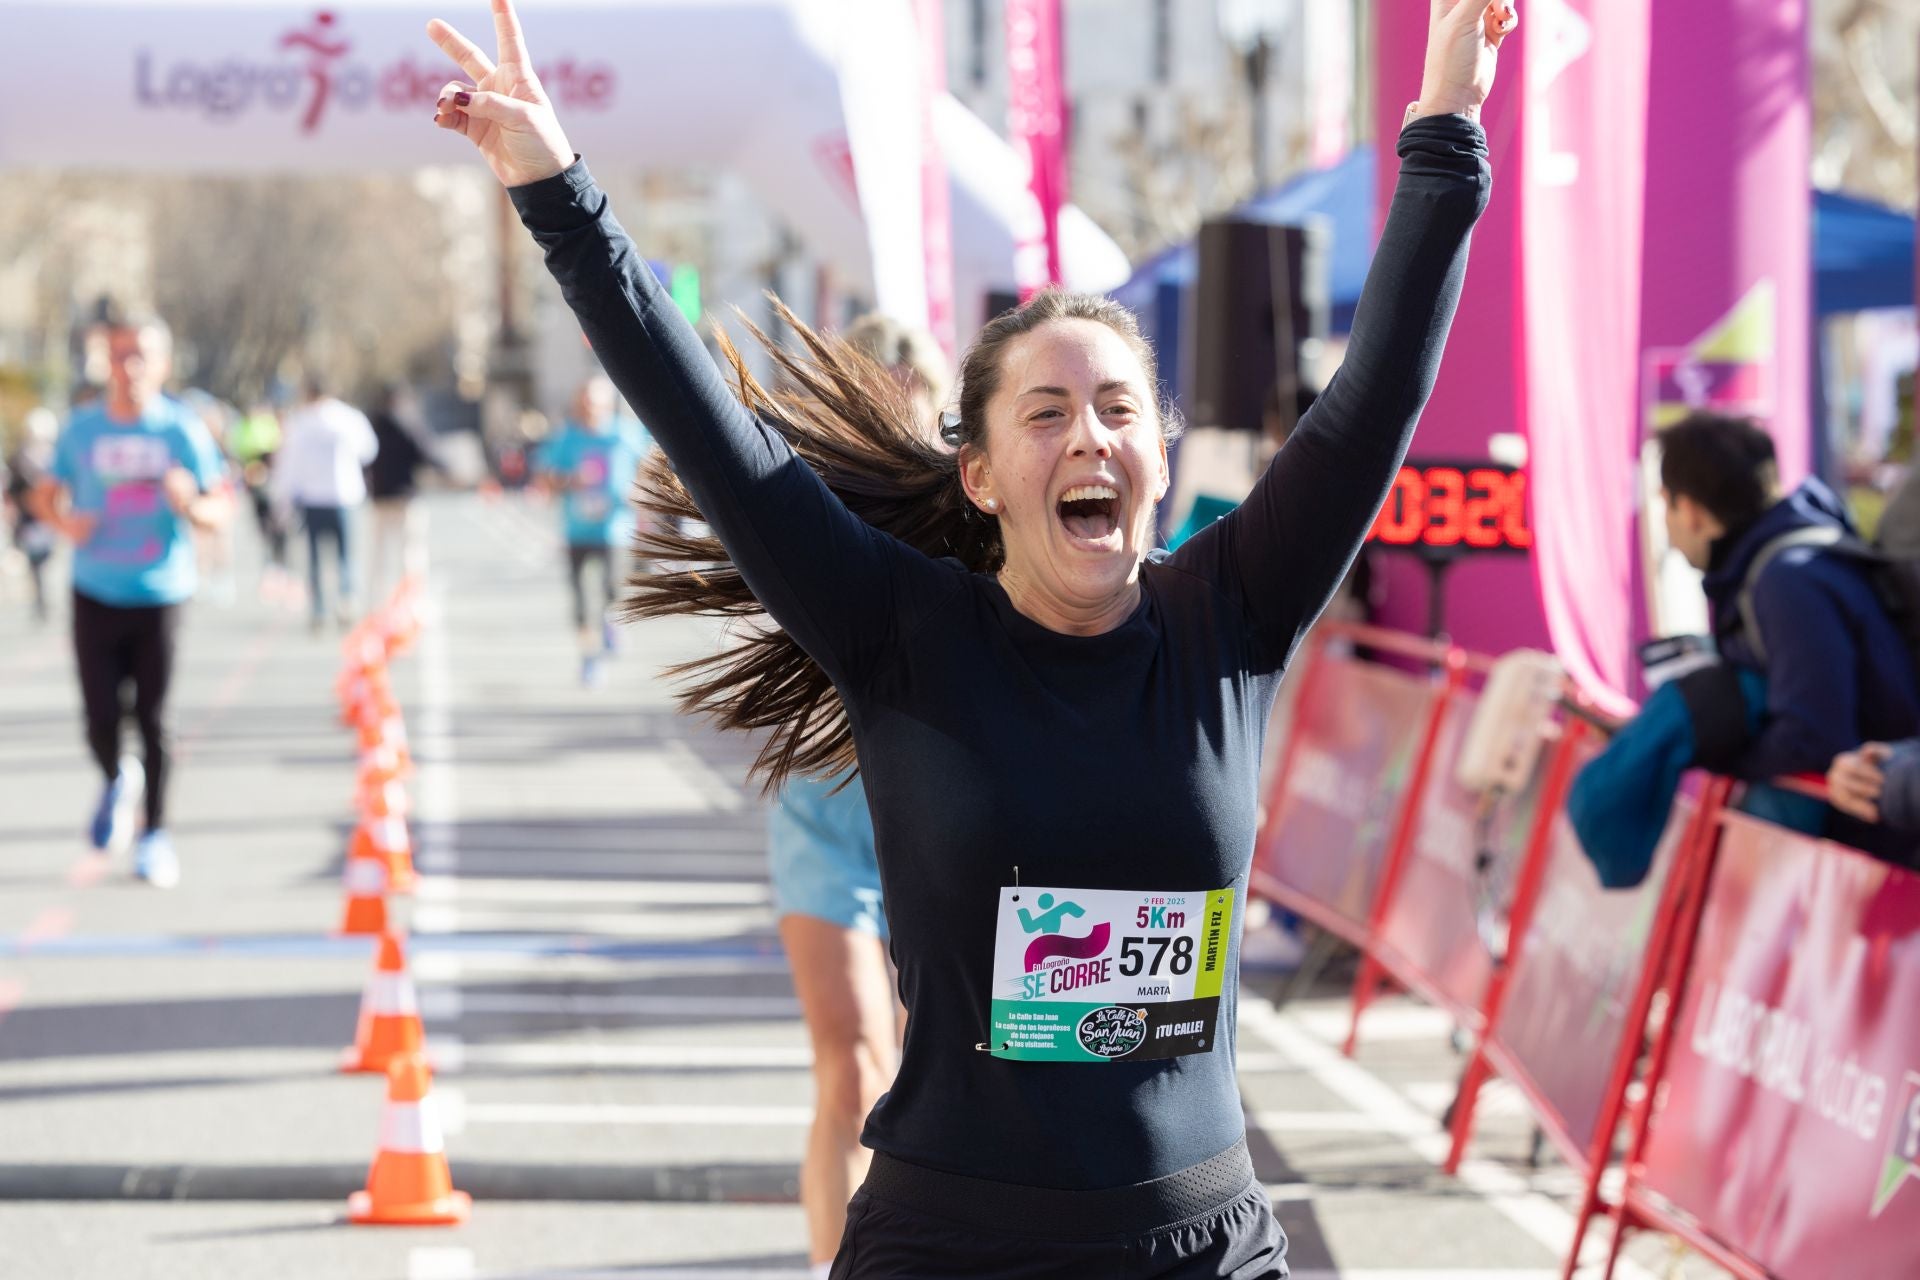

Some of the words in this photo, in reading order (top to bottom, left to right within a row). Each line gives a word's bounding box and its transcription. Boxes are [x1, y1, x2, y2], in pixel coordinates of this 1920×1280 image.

[1144, 897, 1149, 905] 9
[1151, 897, 1165, 905] FEB
[1167, 897, 1186, 905] 2025
[1136, 905, 1186, 929] 5Km
[1210, 909, 1223, 927] FIZ
[1118, 935, 1194, 977] 578
[1204, 929, 1221, 972] MARTÍN
[1043, 957, 1070, 970] Logroño
[1022, 971, 1047, 1001] SE
[1050, 957, 1113, 994] CORRE
[1137, 985, 1171, 996] MARTA
[1008, 1012, 1016, 1020] La
[1016, 1013, 1032, 1021] Calle
[1033, 1013, 1045, 1021] San
[1045, 1013, 1059, 1021] Juan
[1095, 1011, 1107, 1024] La
[1105, 1009, 1127, 1021] Calle
[995, 1021, 1002, 1029] La
[1002, 1022, 1018, 1031] calle
[1018, 1023, 1027, 1031] de
[1027, 1023, 1036, 1031] los
[1081, 1021, 1110, 1043] San
[1108, 1020, 1141, 1045] Juan
[1155, 1024, 1172, 1040] ¡TU
[1173, 1020, 1204, 1036] CALLE!
[1019, 1032, 1029, 1040] los
[1029, 1032, 1055, 1040] riojanos
[1014, 1040, 1025, 1048] los
